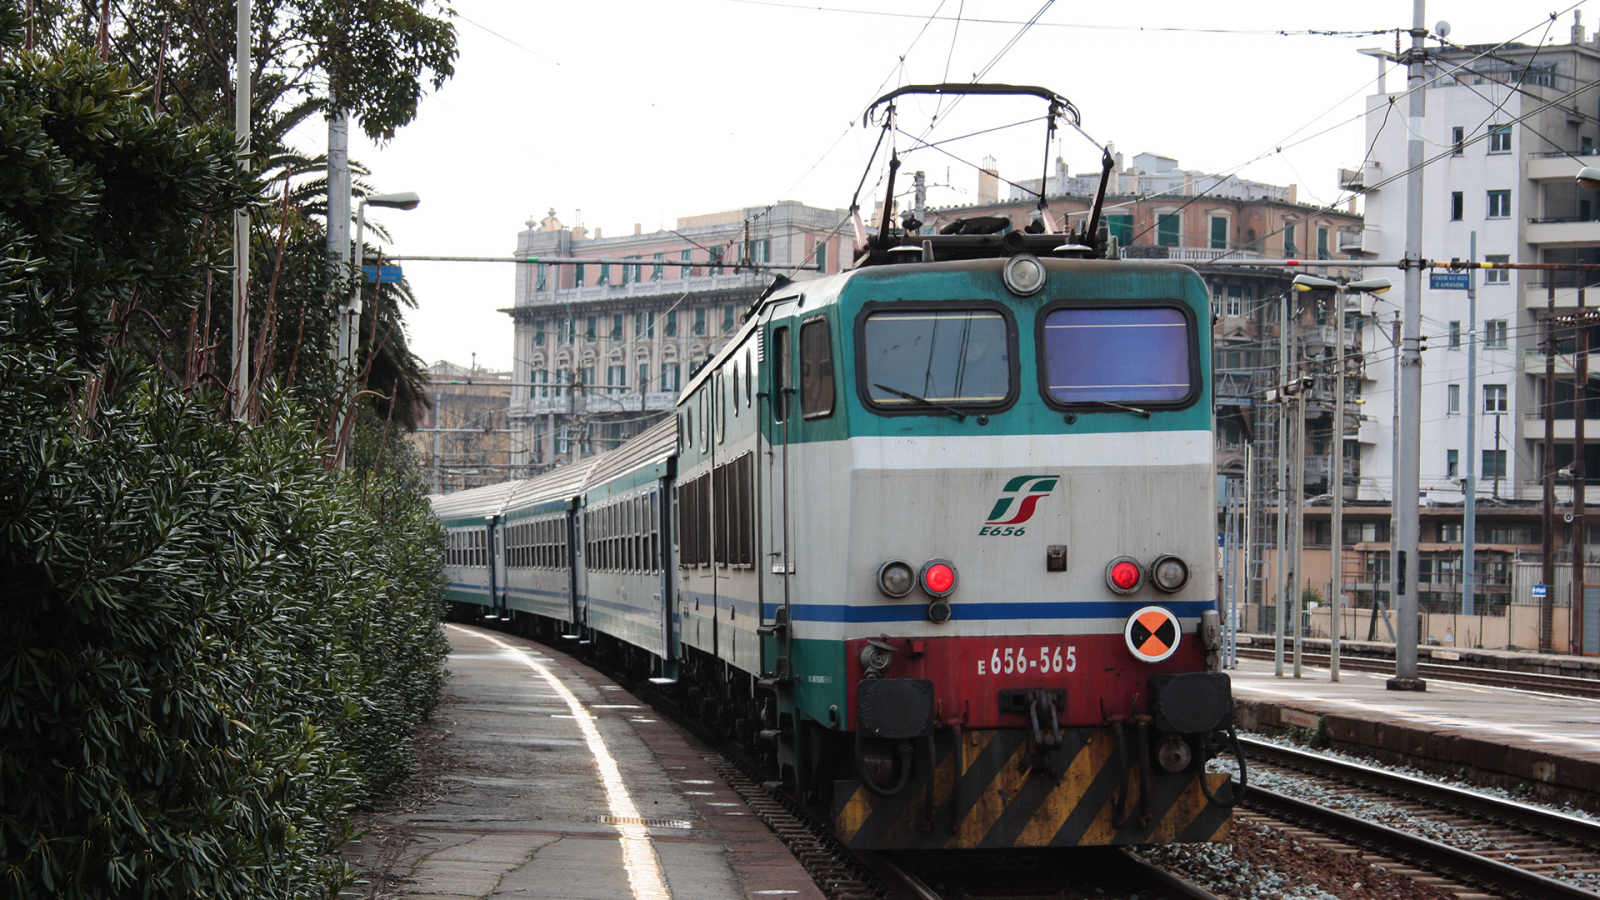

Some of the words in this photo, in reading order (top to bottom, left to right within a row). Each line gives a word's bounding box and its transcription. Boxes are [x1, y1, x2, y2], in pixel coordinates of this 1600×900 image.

[978, 526, 1026, 537] E656
[978, 660, 986, 675] E
[991, 646, 1077, 675] 656-565
